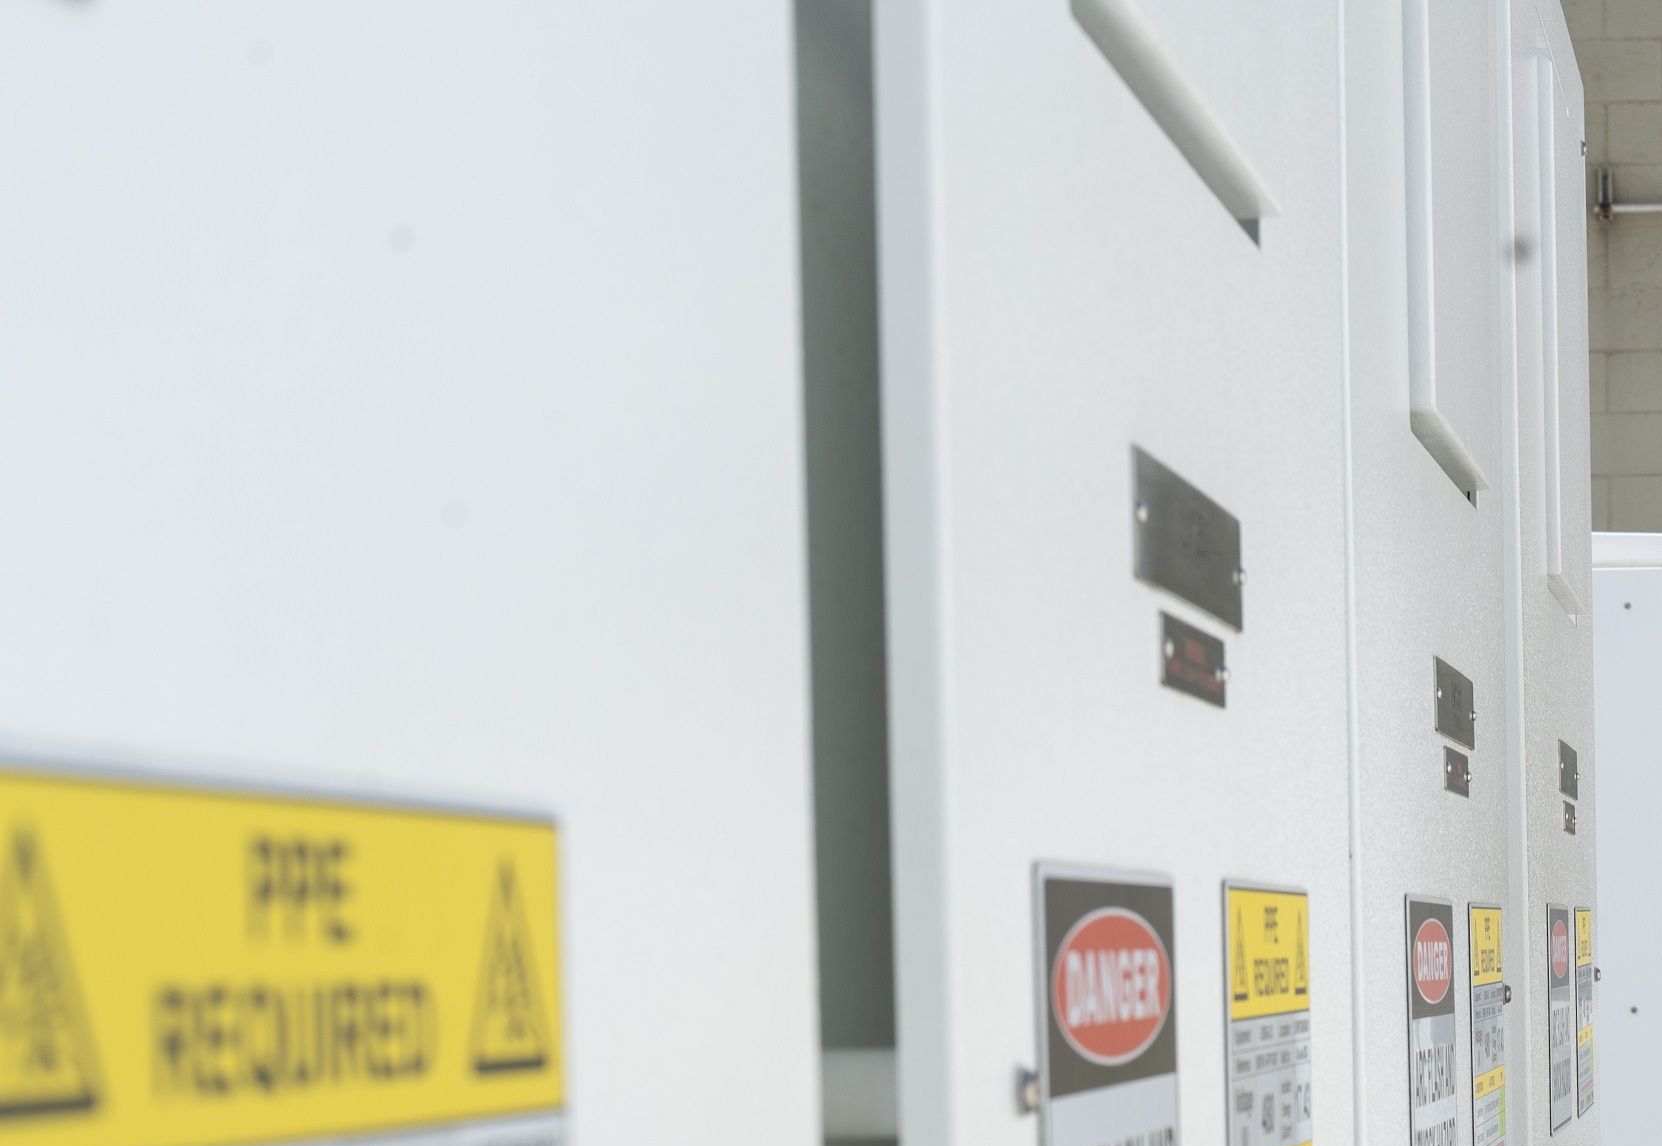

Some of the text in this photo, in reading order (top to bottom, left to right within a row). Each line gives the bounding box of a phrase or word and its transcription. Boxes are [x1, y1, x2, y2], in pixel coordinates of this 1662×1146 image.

[246, 834, 355, 946] PPE
[1065, 946, 1161, 1028] DANGER
[1416, 940, 1449, 982] DANGER
[150, 977, 438, 1106] REQUIRED
[1415, 1043, 1456, 1109] ARC FLASH AND
